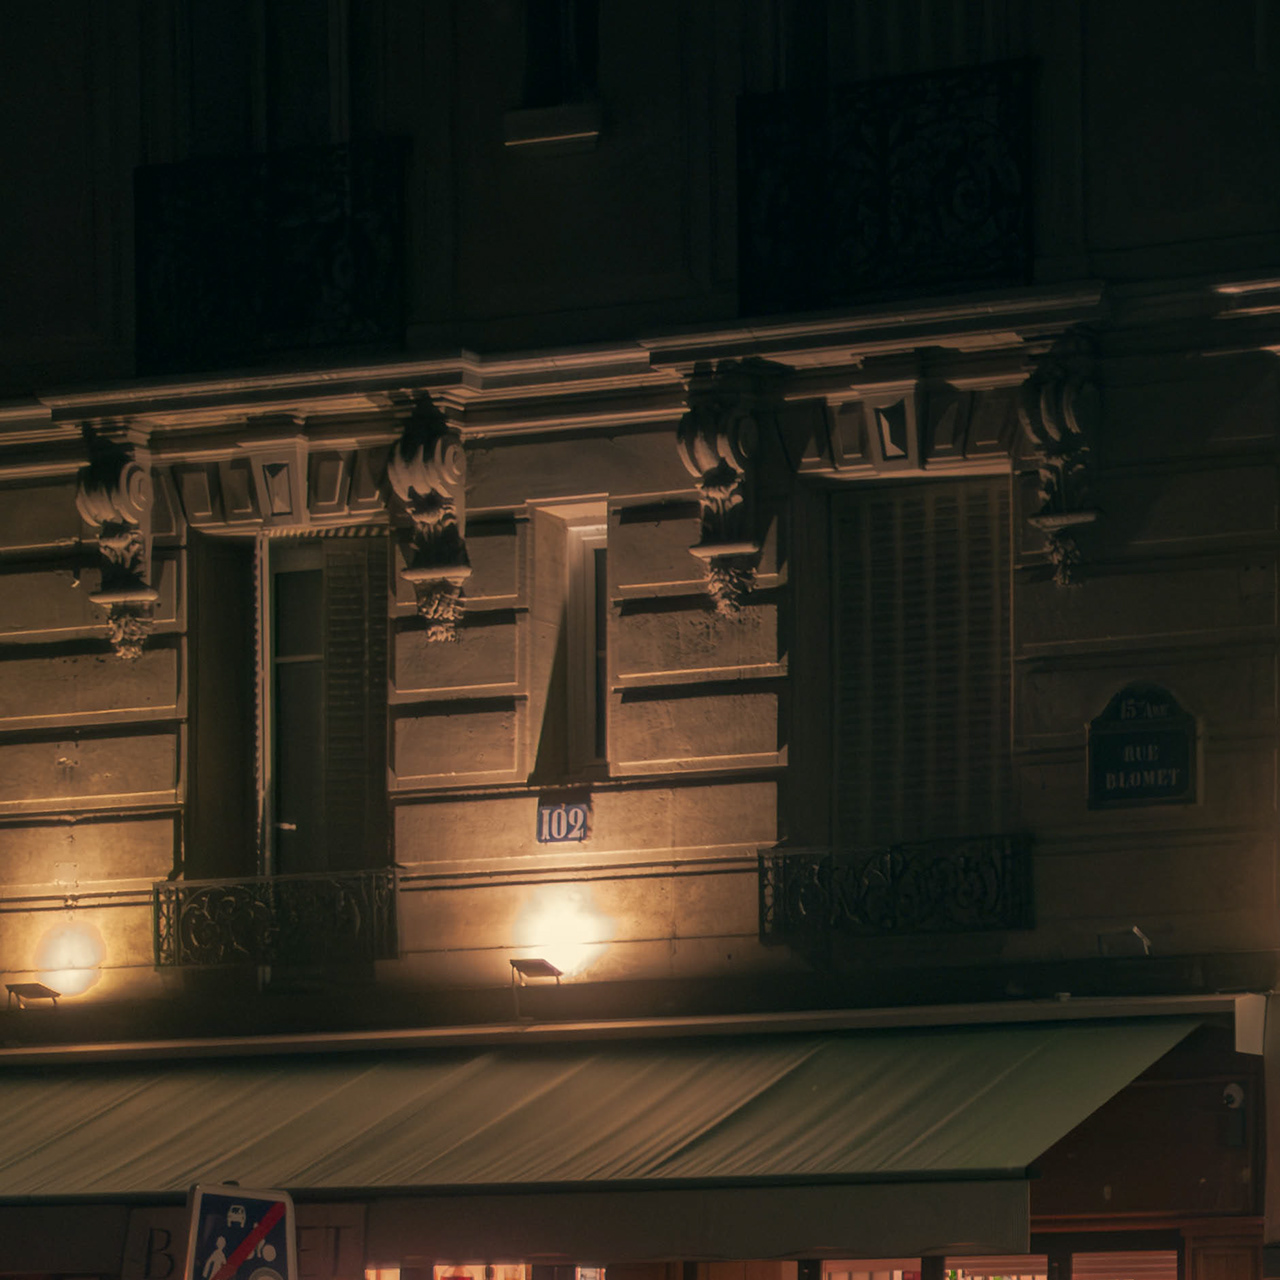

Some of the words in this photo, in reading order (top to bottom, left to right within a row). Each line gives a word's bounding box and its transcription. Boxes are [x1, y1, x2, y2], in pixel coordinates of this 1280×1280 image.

[1125, 744, 1160, 762] RUE
[1106, 769, 1178, 790] BLOMET
[541, 807, 585, 840] 102
